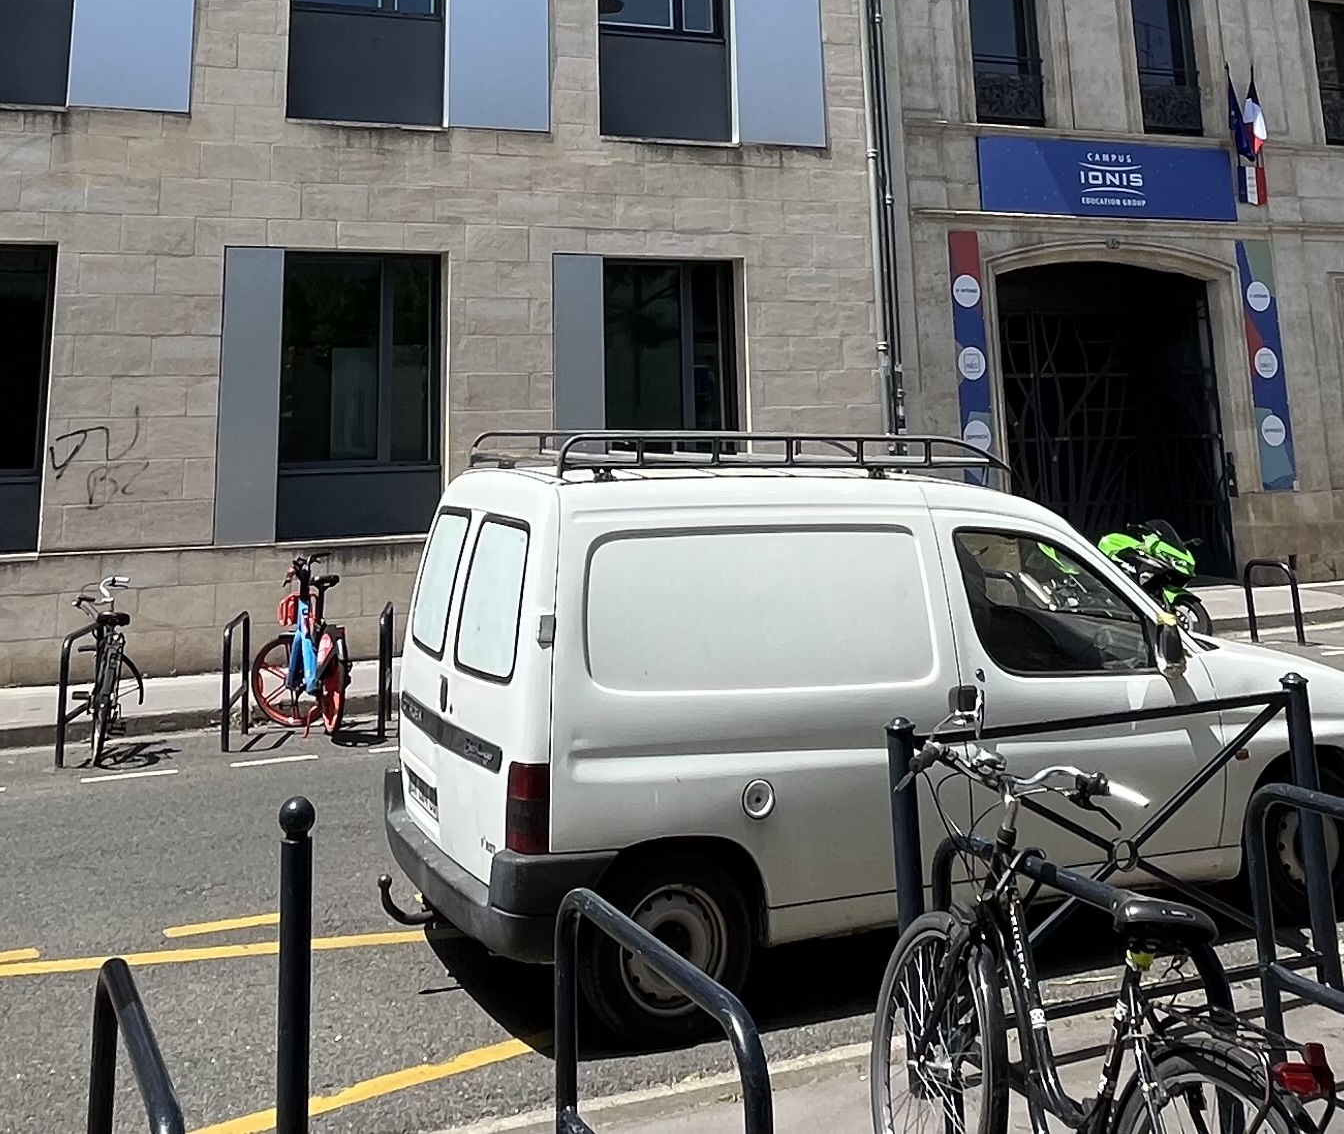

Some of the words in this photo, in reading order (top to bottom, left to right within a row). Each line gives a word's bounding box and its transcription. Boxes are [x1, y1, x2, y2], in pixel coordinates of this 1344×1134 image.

[1086, 152, 1132, 163] CAMPUS
[1079, 170, 1144, 187] IONIS
[1081, 196, 1121, 206] EDUCATION
[1122, 198, 1146, 207] GROUP
